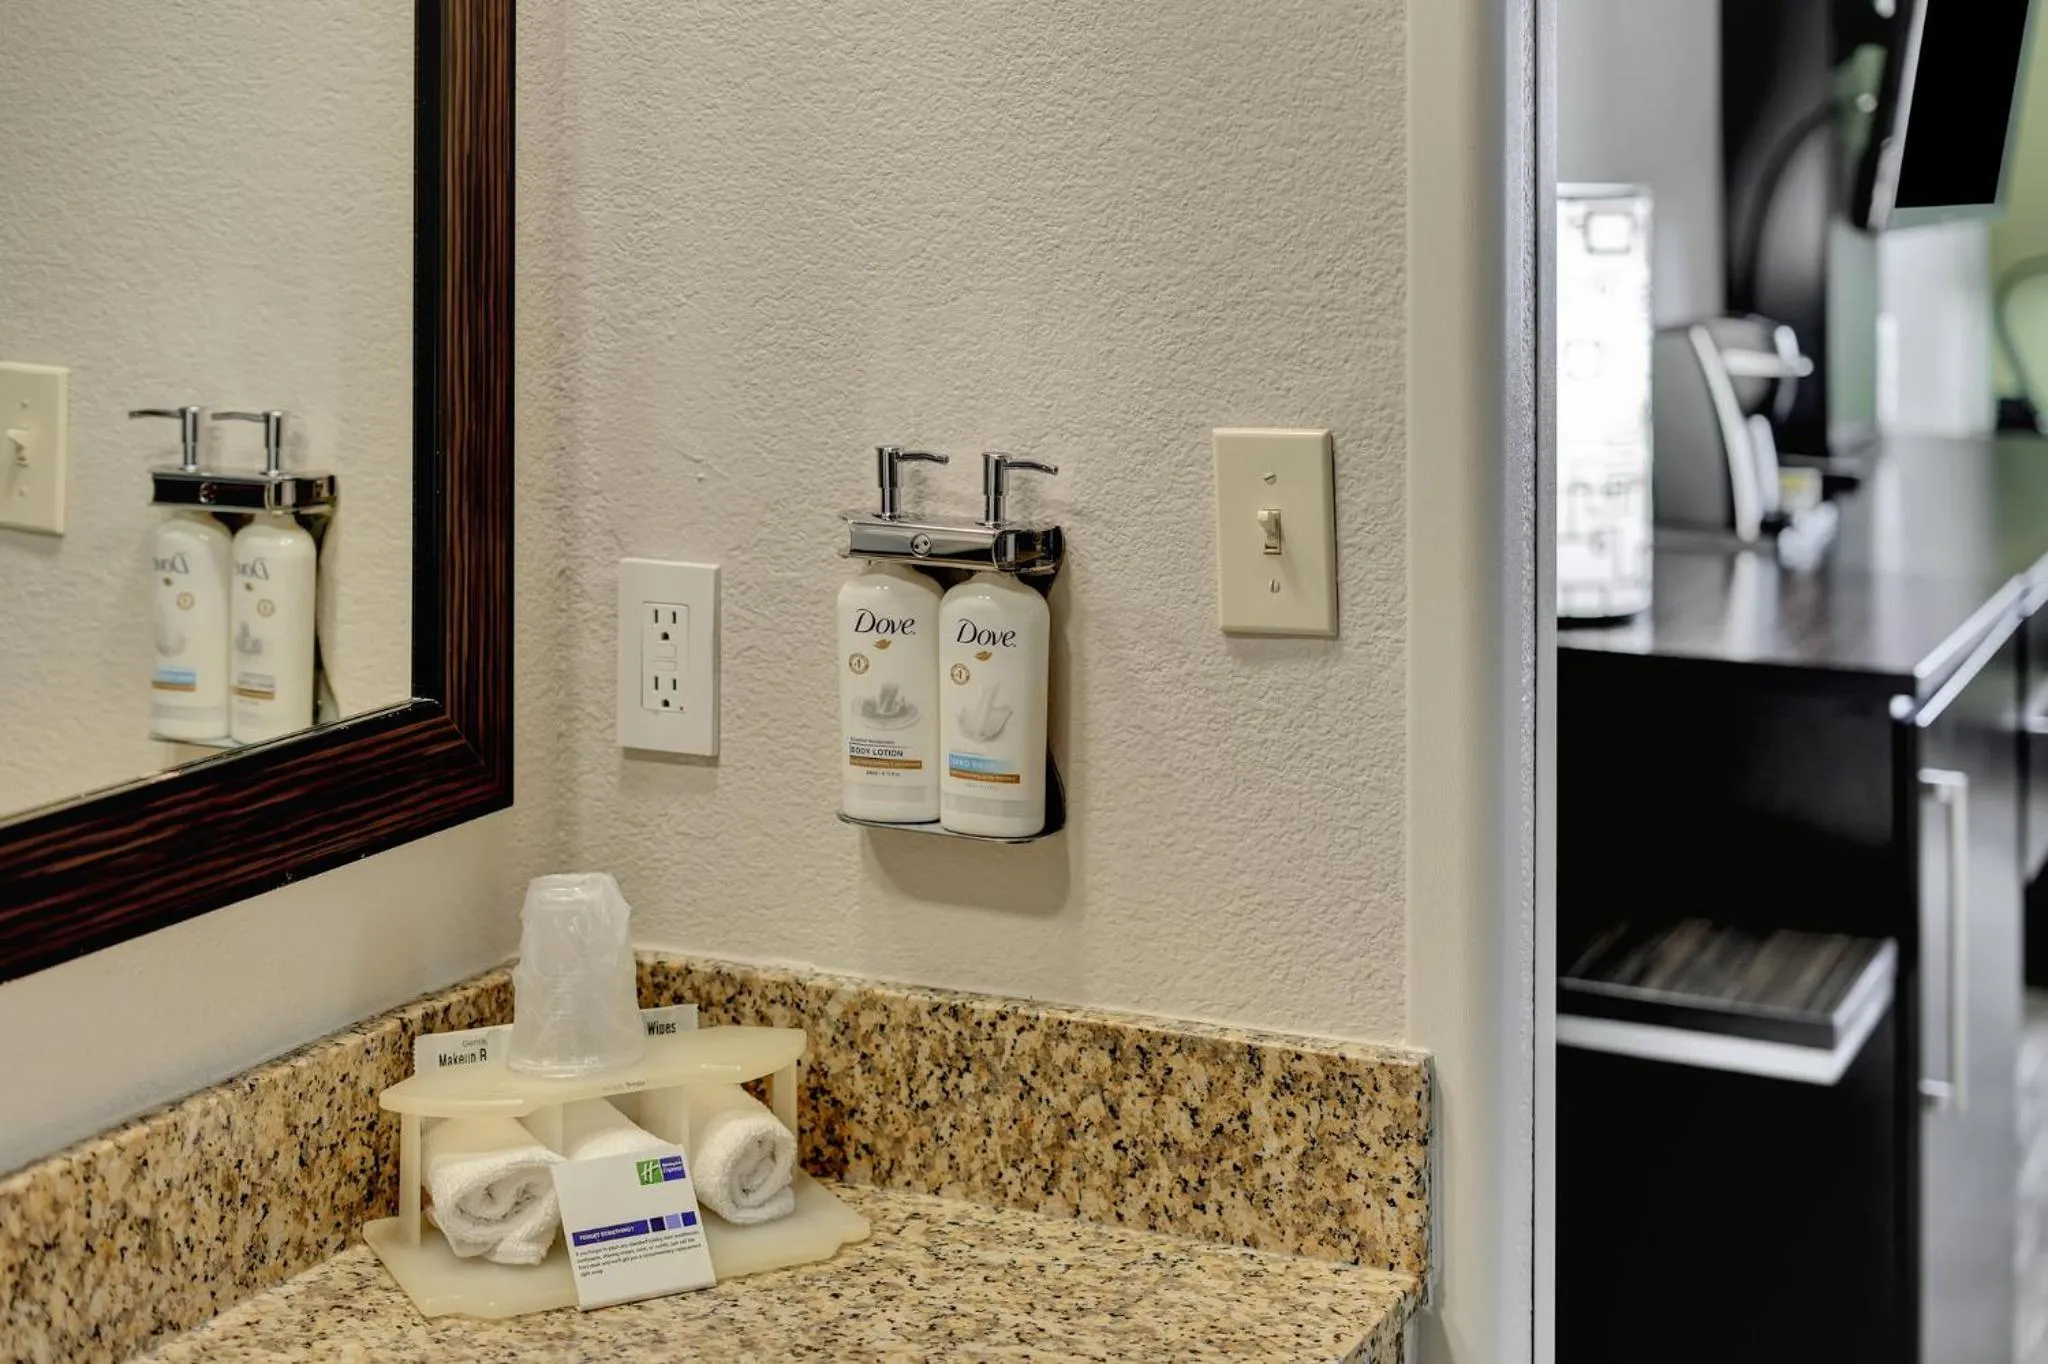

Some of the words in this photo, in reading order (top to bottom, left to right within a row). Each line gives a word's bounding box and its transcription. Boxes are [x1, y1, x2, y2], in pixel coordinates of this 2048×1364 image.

[854, 608, 915, 635] Dove
[956, 618, 1016, 647] Dove
[850, 746, 870, 755] BODY
[872, 748, 904, 757] LOTION
[646, 1020, 676, 1036] Wipes
